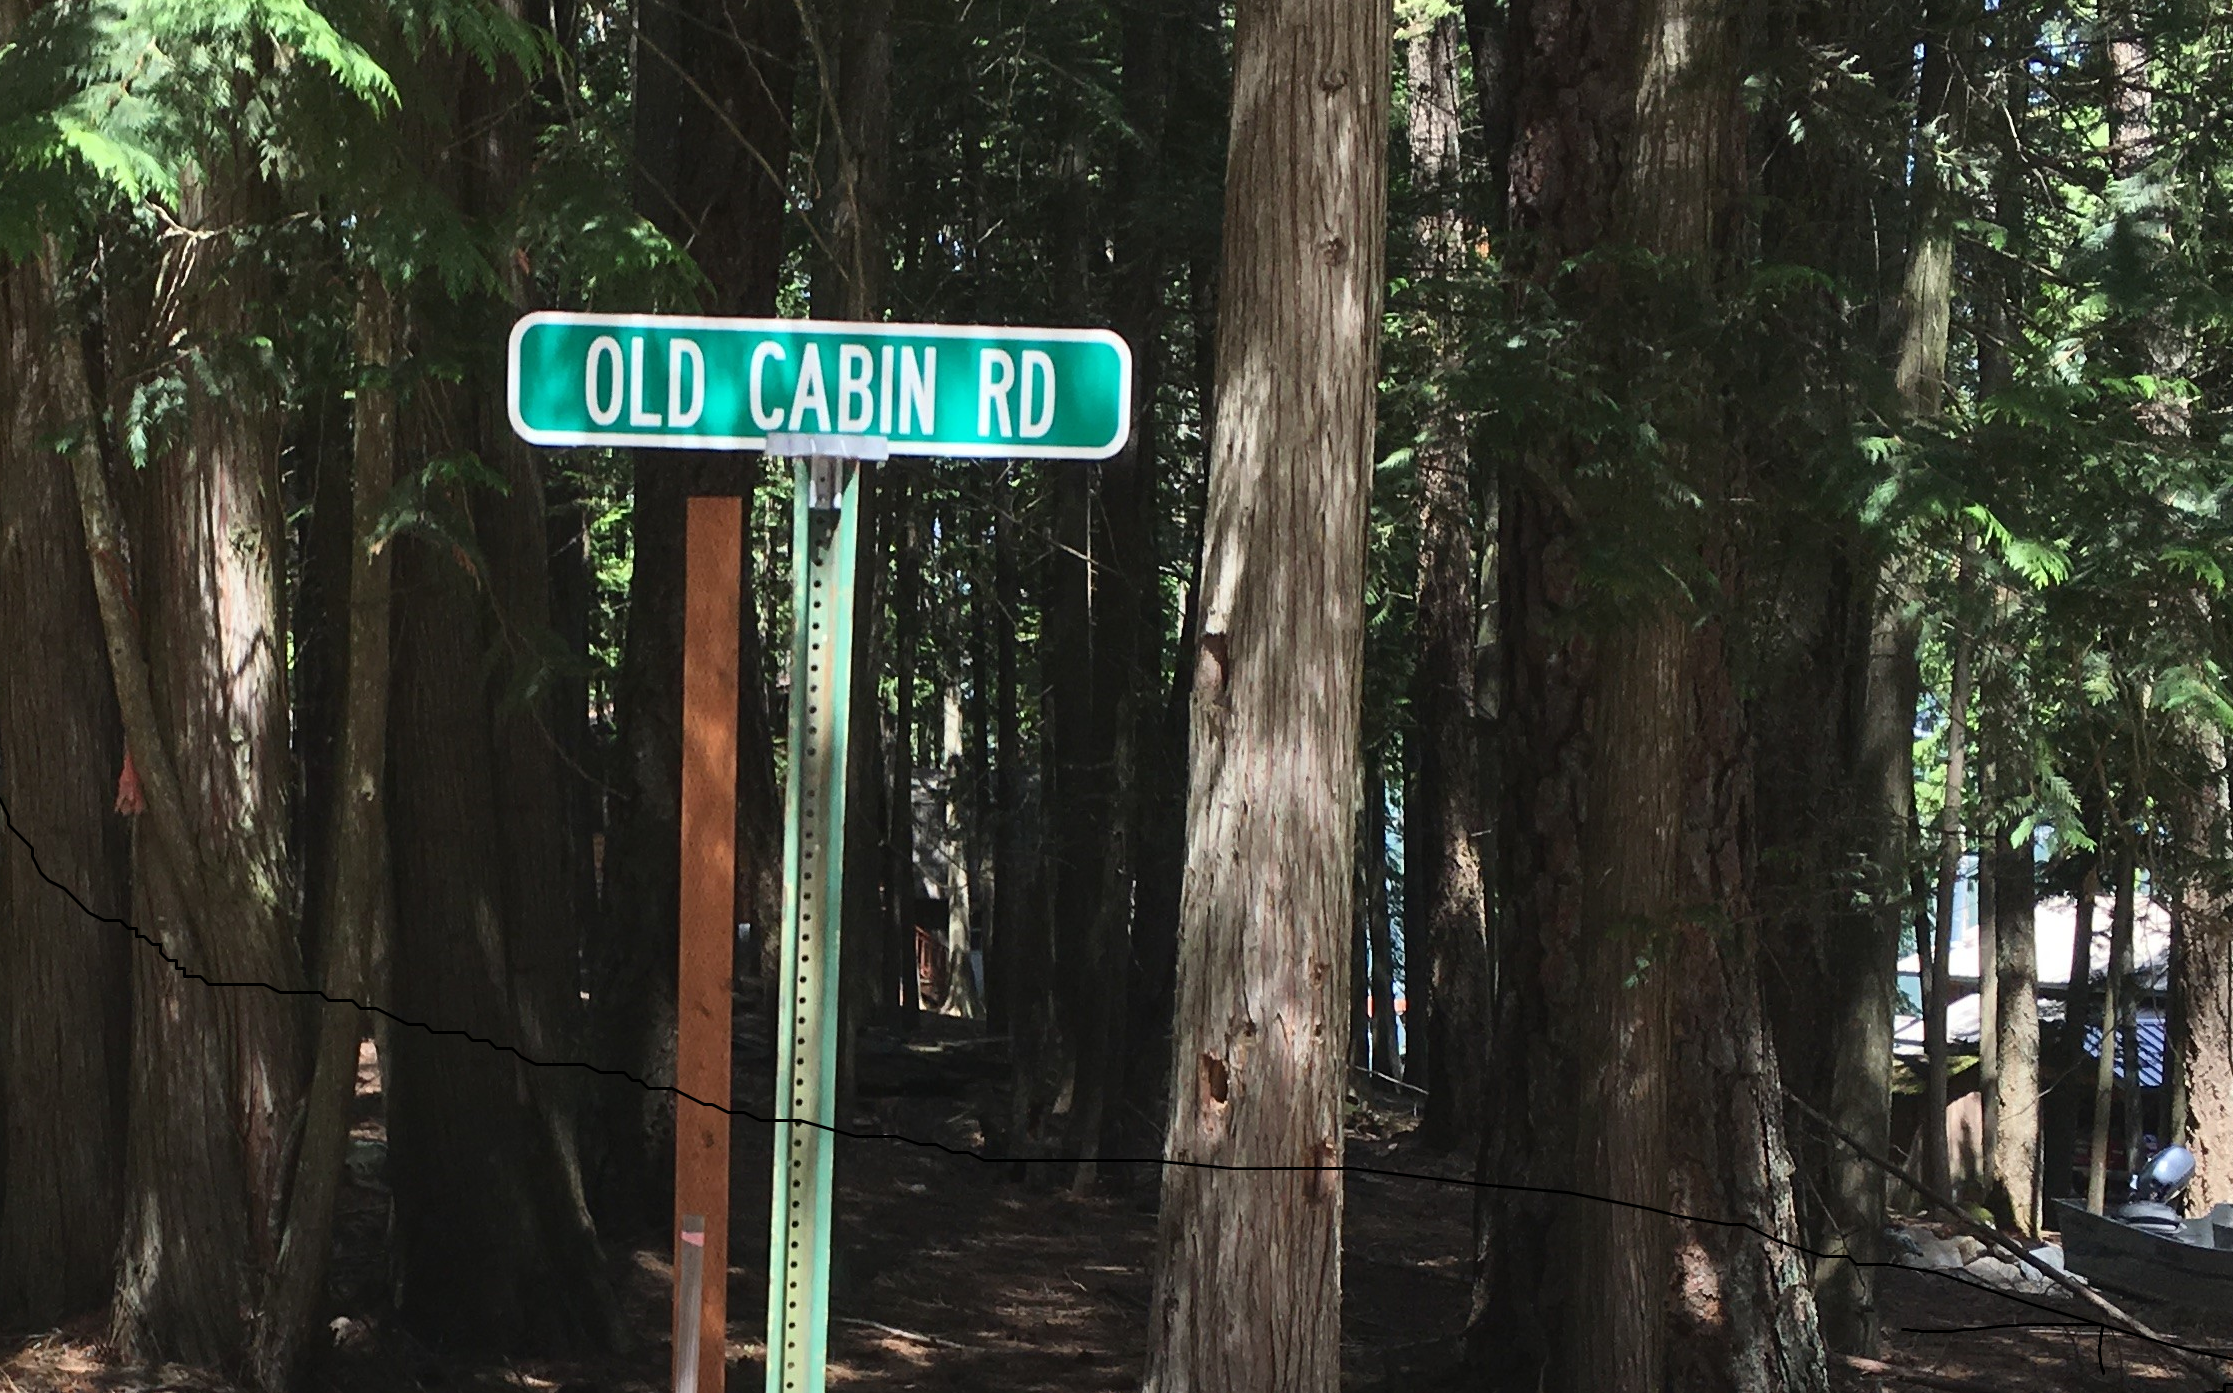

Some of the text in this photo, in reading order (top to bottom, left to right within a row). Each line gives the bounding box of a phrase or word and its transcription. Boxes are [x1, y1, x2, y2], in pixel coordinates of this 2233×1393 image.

[585, 336, 1056, 438] OLD CABIN RD
